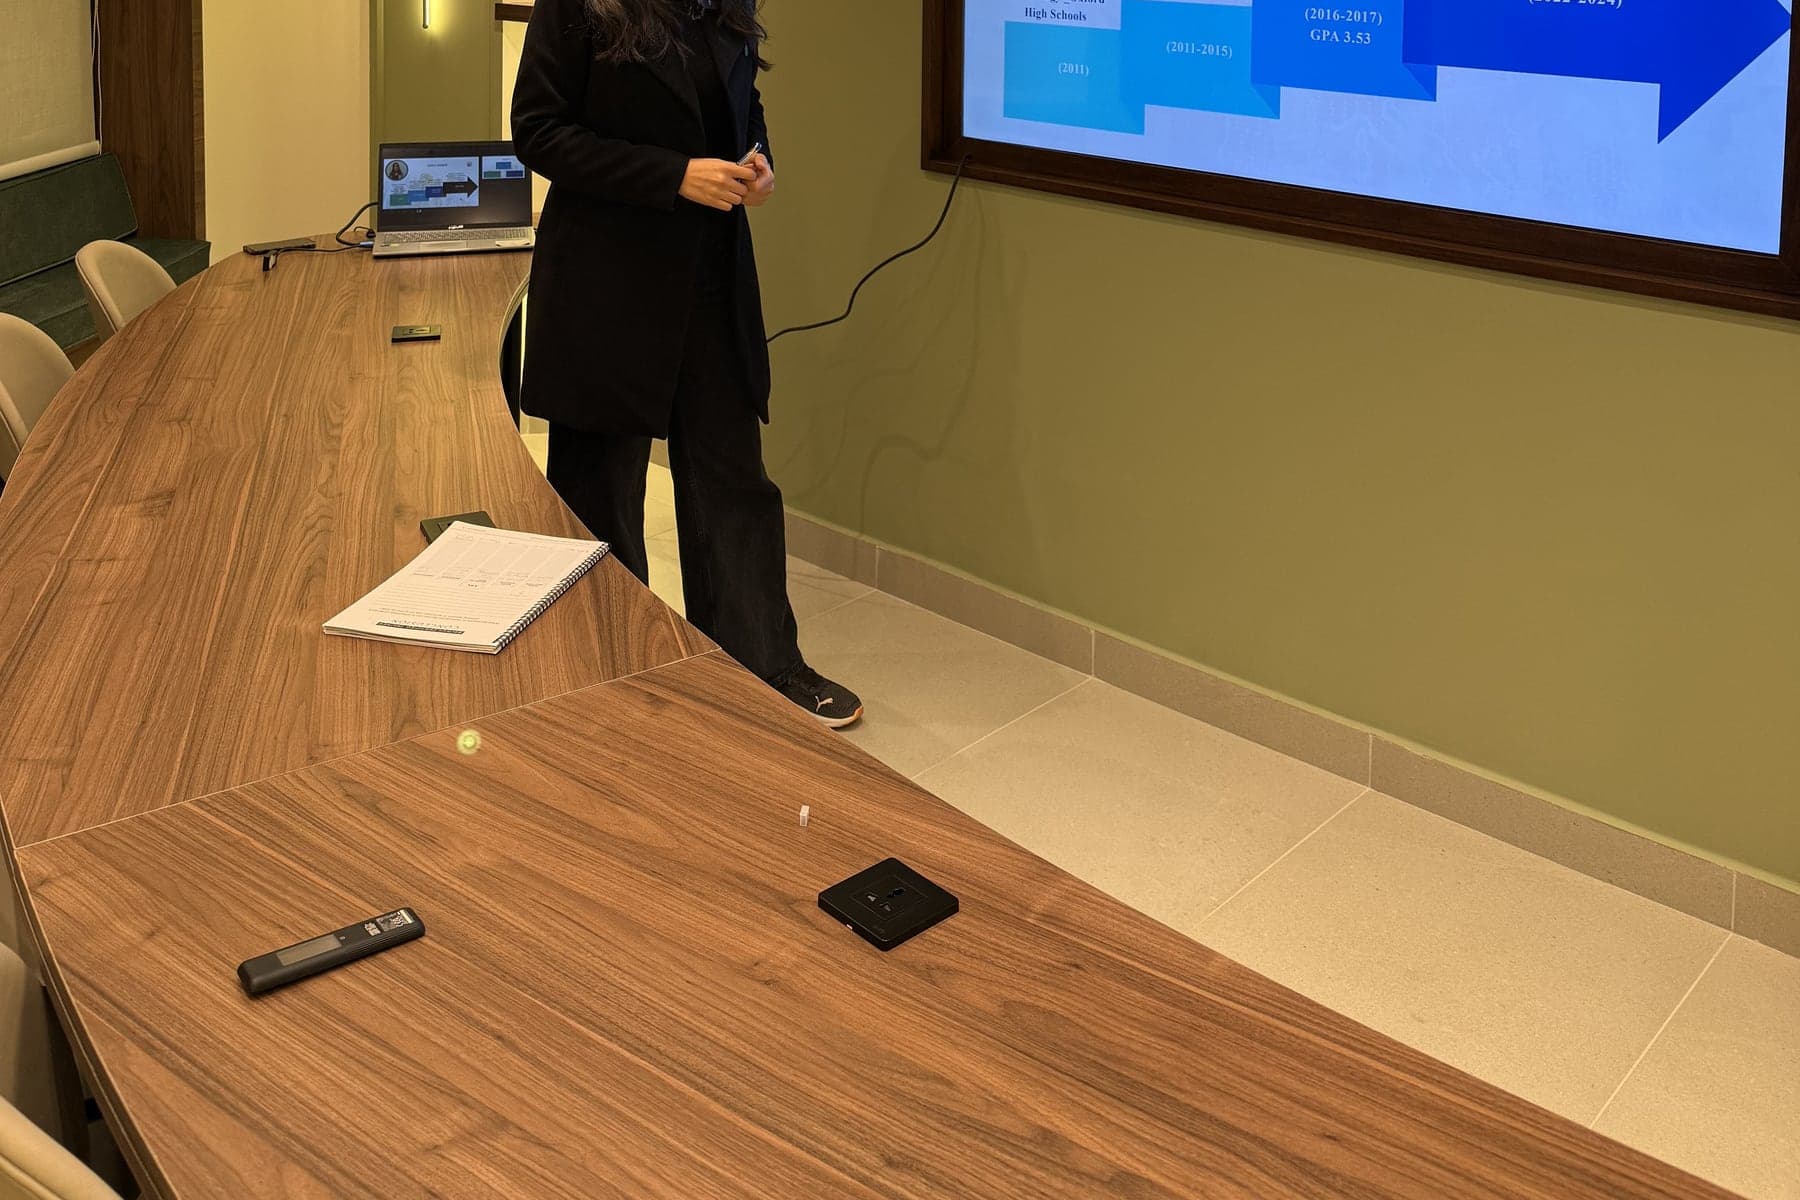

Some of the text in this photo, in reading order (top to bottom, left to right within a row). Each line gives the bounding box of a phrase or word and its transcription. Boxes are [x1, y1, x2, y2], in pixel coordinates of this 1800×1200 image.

[1024, 7, 1087, 22] High Schools
[1304, 7, 1383, 26] (2016-2017)
[1310, 28, 1371, 45] GPA 3.53
[1165, 40, 1233, 59] (2011-2015)
[1058, 62, 1090, 77] (2011)
